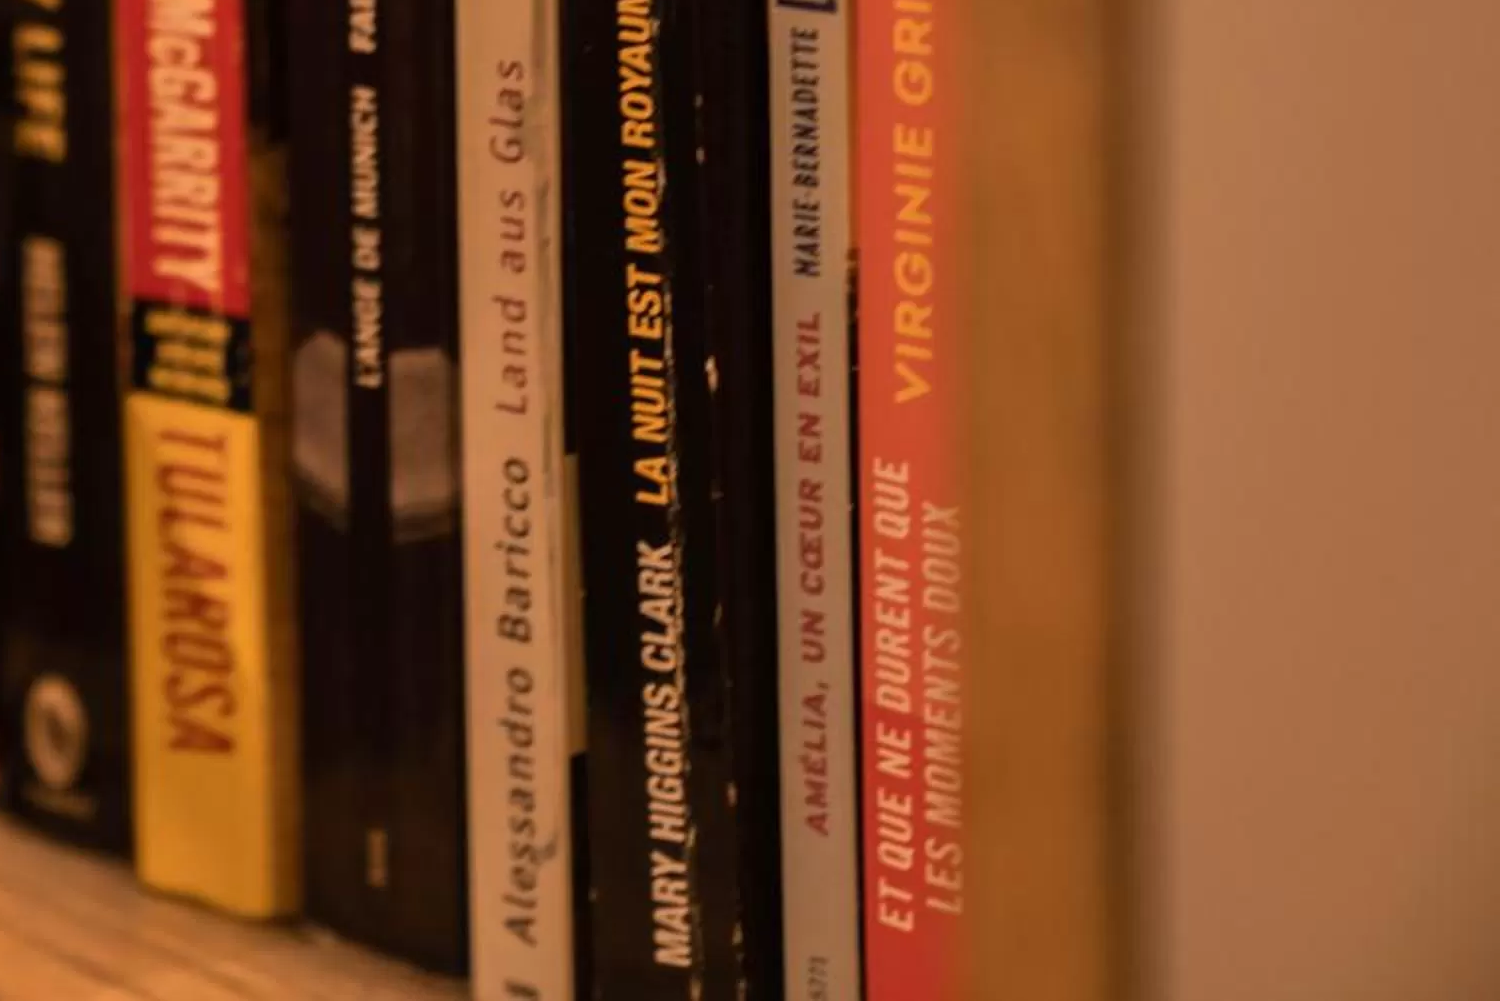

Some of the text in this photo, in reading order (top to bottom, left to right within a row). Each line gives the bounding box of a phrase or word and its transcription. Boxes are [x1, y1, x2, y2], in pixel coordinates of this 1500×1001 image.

[488, 59, 525, 166] Glas
[499, 189, 527, 274] aus
[622, 159, 663, 254] MON
[892, 122, 933, 405] VIRGINIE
[495, 294, 528, 416] Land
[626, 262, 665, 340] EST
[796, 311, 822, 399] EXIL
[628, 348, 669, 443] NUIT
[797, 414, 823, 465] EN
[633, 456, 671, 506] LA
[156, 427, 236, 755] TULAROSA
[496, 455, 533, 646] Baricco
[636, 539, 676, 674] CLARK
[800, 608, 827, 664] UN
[872, 456, 915, 933] ET QUE NE DURENT QUE
[643, 682, 687, 846] HIGGINS
[921, 500, 964, 916] LES MOMENTS DOUX
[498, 665, 538, 950] Alessandro
[649, 850, 693, 969] MARY
